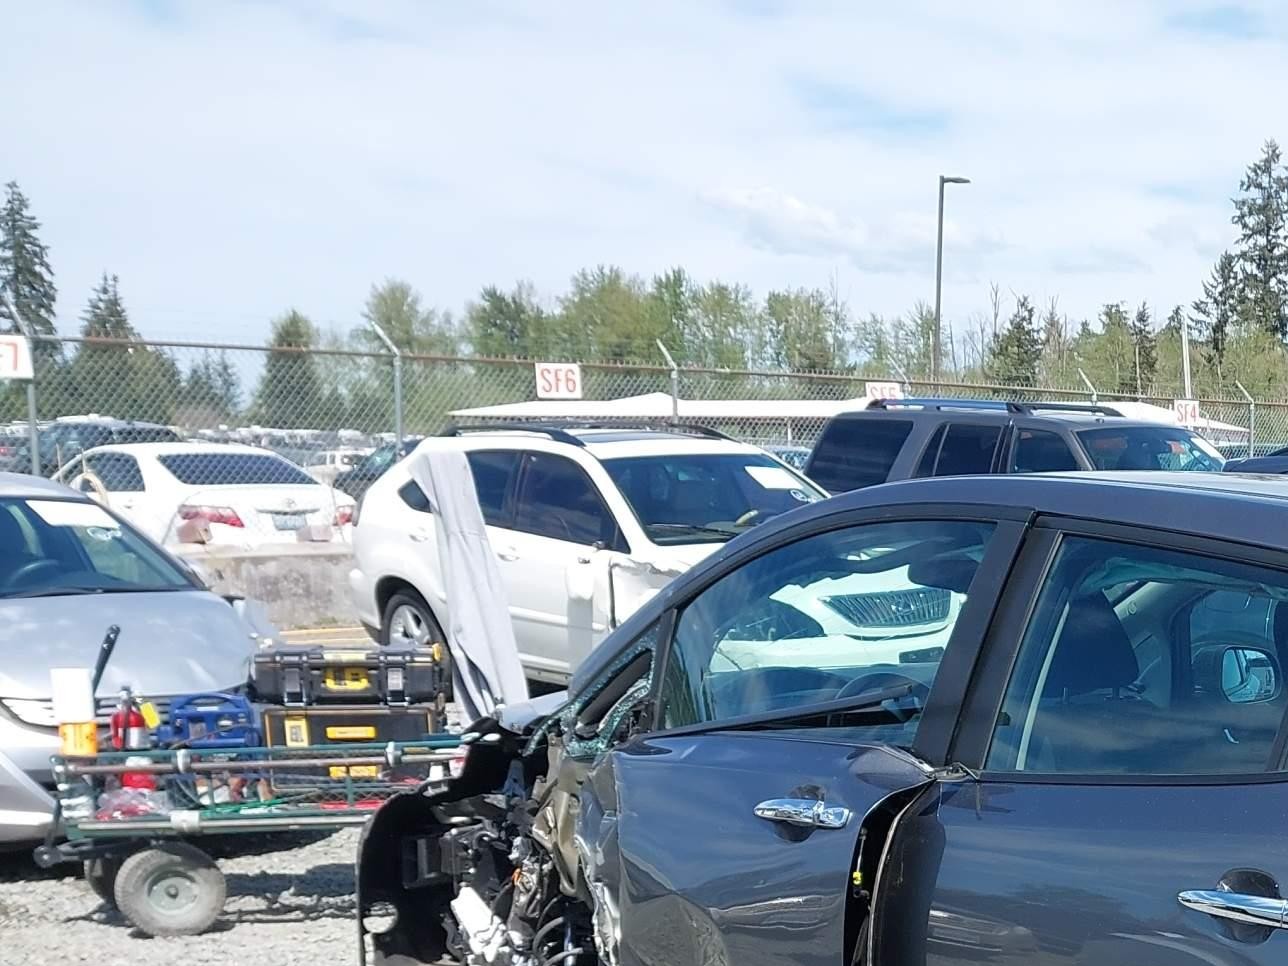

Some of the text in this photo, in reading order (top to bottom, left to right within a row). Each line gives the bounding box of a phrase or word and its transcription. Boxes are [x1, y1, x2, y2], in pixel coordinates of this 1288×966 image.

[0, 342, 18, 371] 7
[540, 368, 577, 393] SF6
[1176, 403, 1197, 423] SF4
